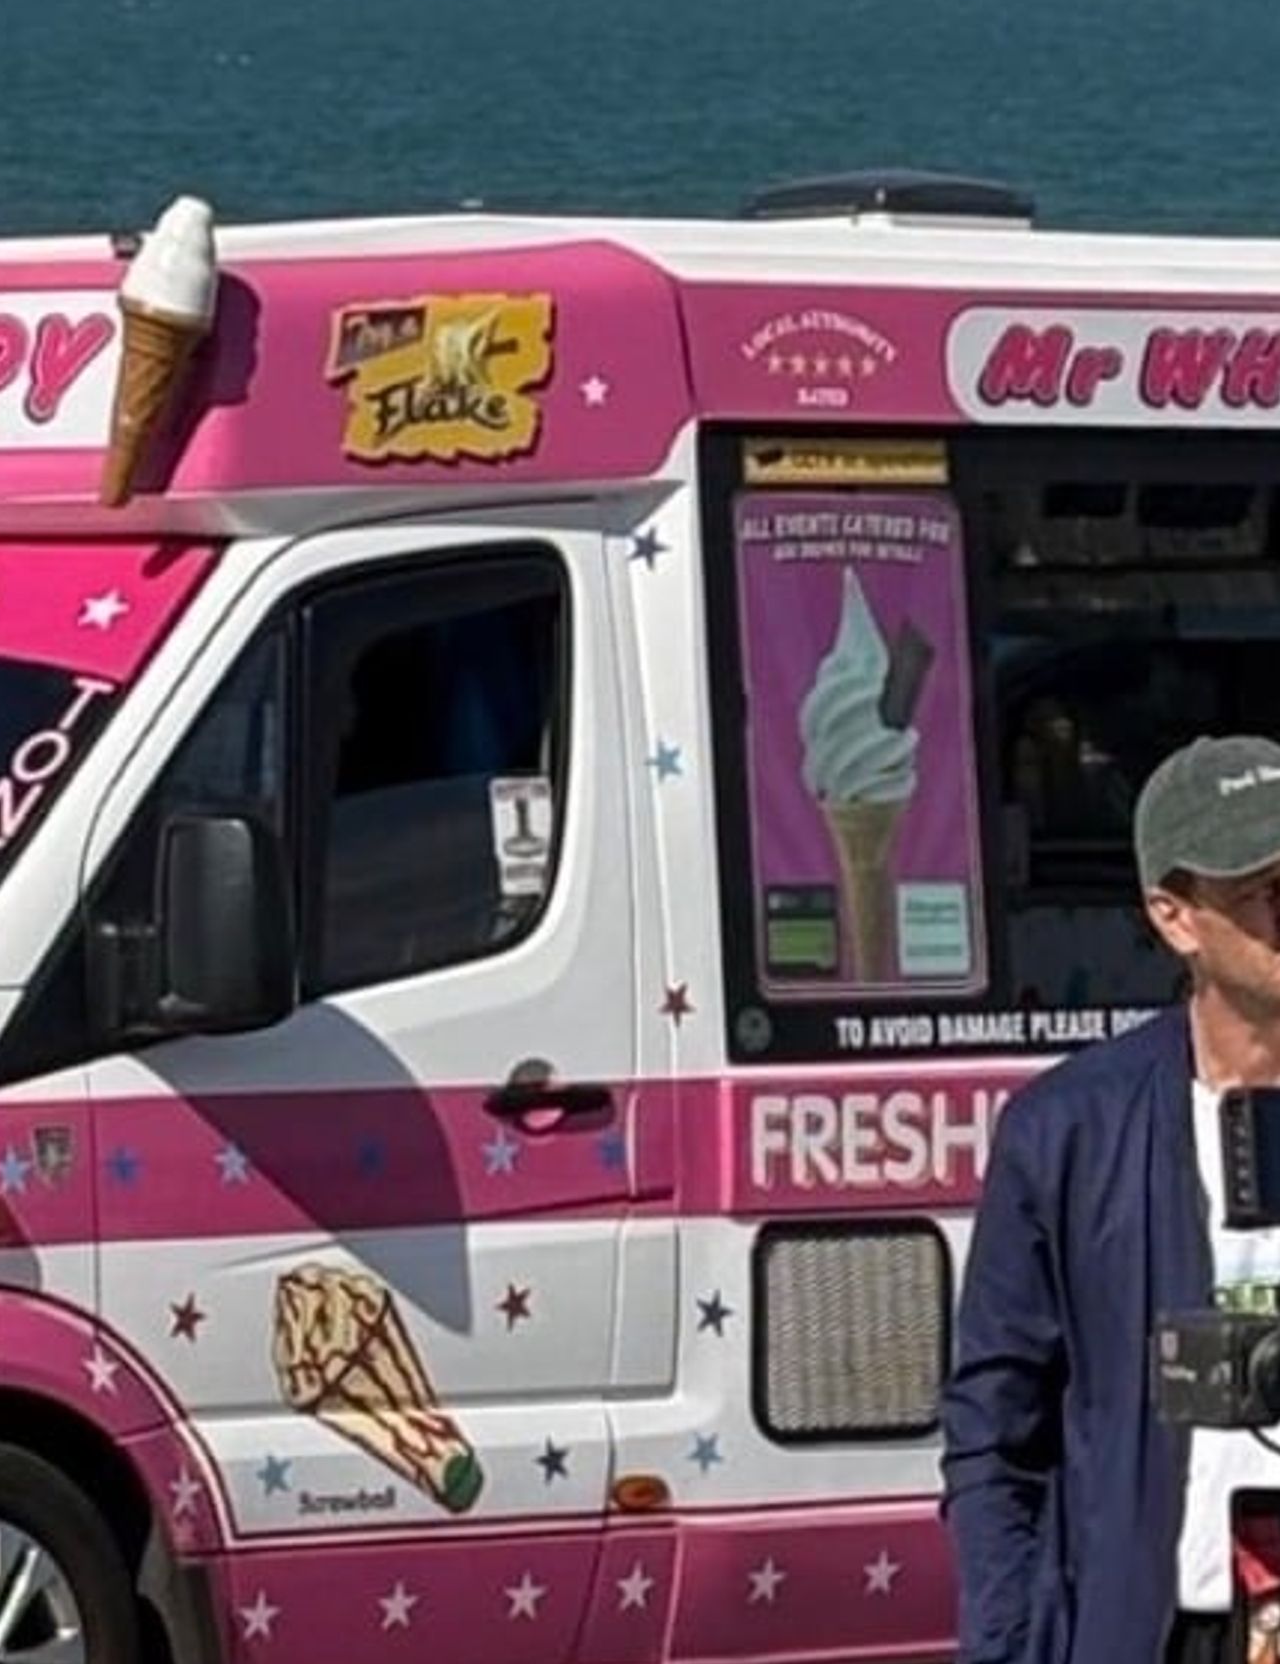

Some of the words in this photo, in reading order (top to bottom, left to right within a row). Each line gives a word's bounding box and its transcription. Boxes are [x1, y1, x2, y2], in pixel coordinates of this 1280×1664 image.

[977, 323, 1124, 408] Mr
[365, 374, 511, 445] Flake
[742, 517, 770, 540] ALL
[835, 1017, 865, 1049] TO
[870, 1016, 933, 1048] AVOID
[937, 1012, 1026, 1045] DAMAGE
[1029, 1009, 1107, 1042] PLEASE
[750, 1090, 1010, 1188] FRESH
